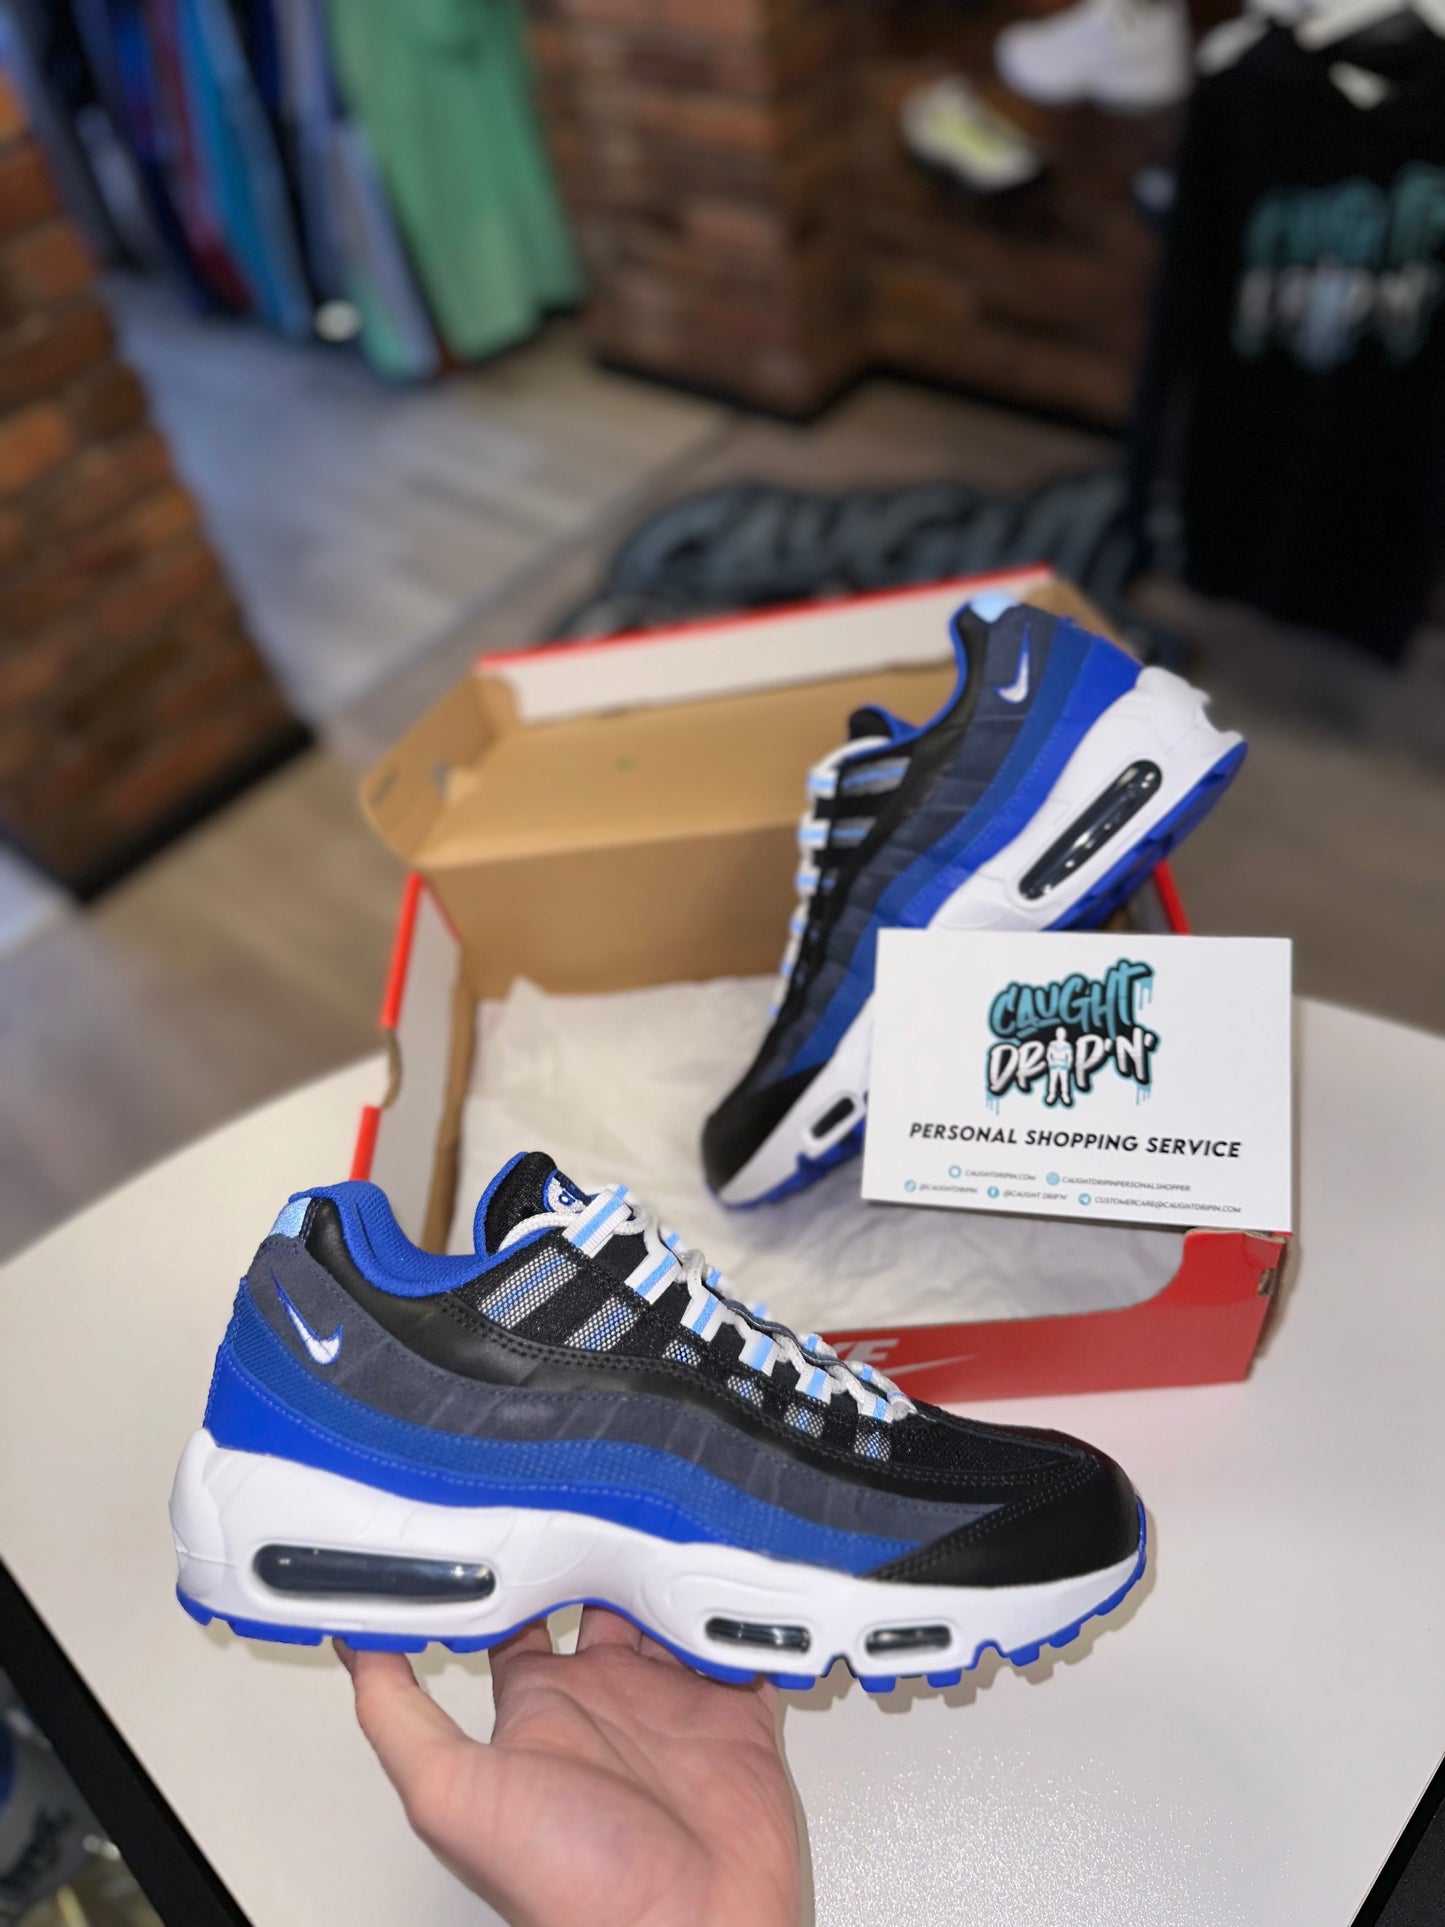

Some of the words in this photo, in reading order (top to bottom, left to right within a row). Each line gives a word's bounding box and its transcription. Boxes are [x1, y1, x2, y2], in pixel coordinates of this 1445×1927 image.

[989, 957, 1153, 1040] CAUGHT
[909, 1122, 1018, 1144] PERSONAL
[1024, 1129, 1138, 1152] SHOPPING
[1145, 1137, 1242, 1158] SERVICE
